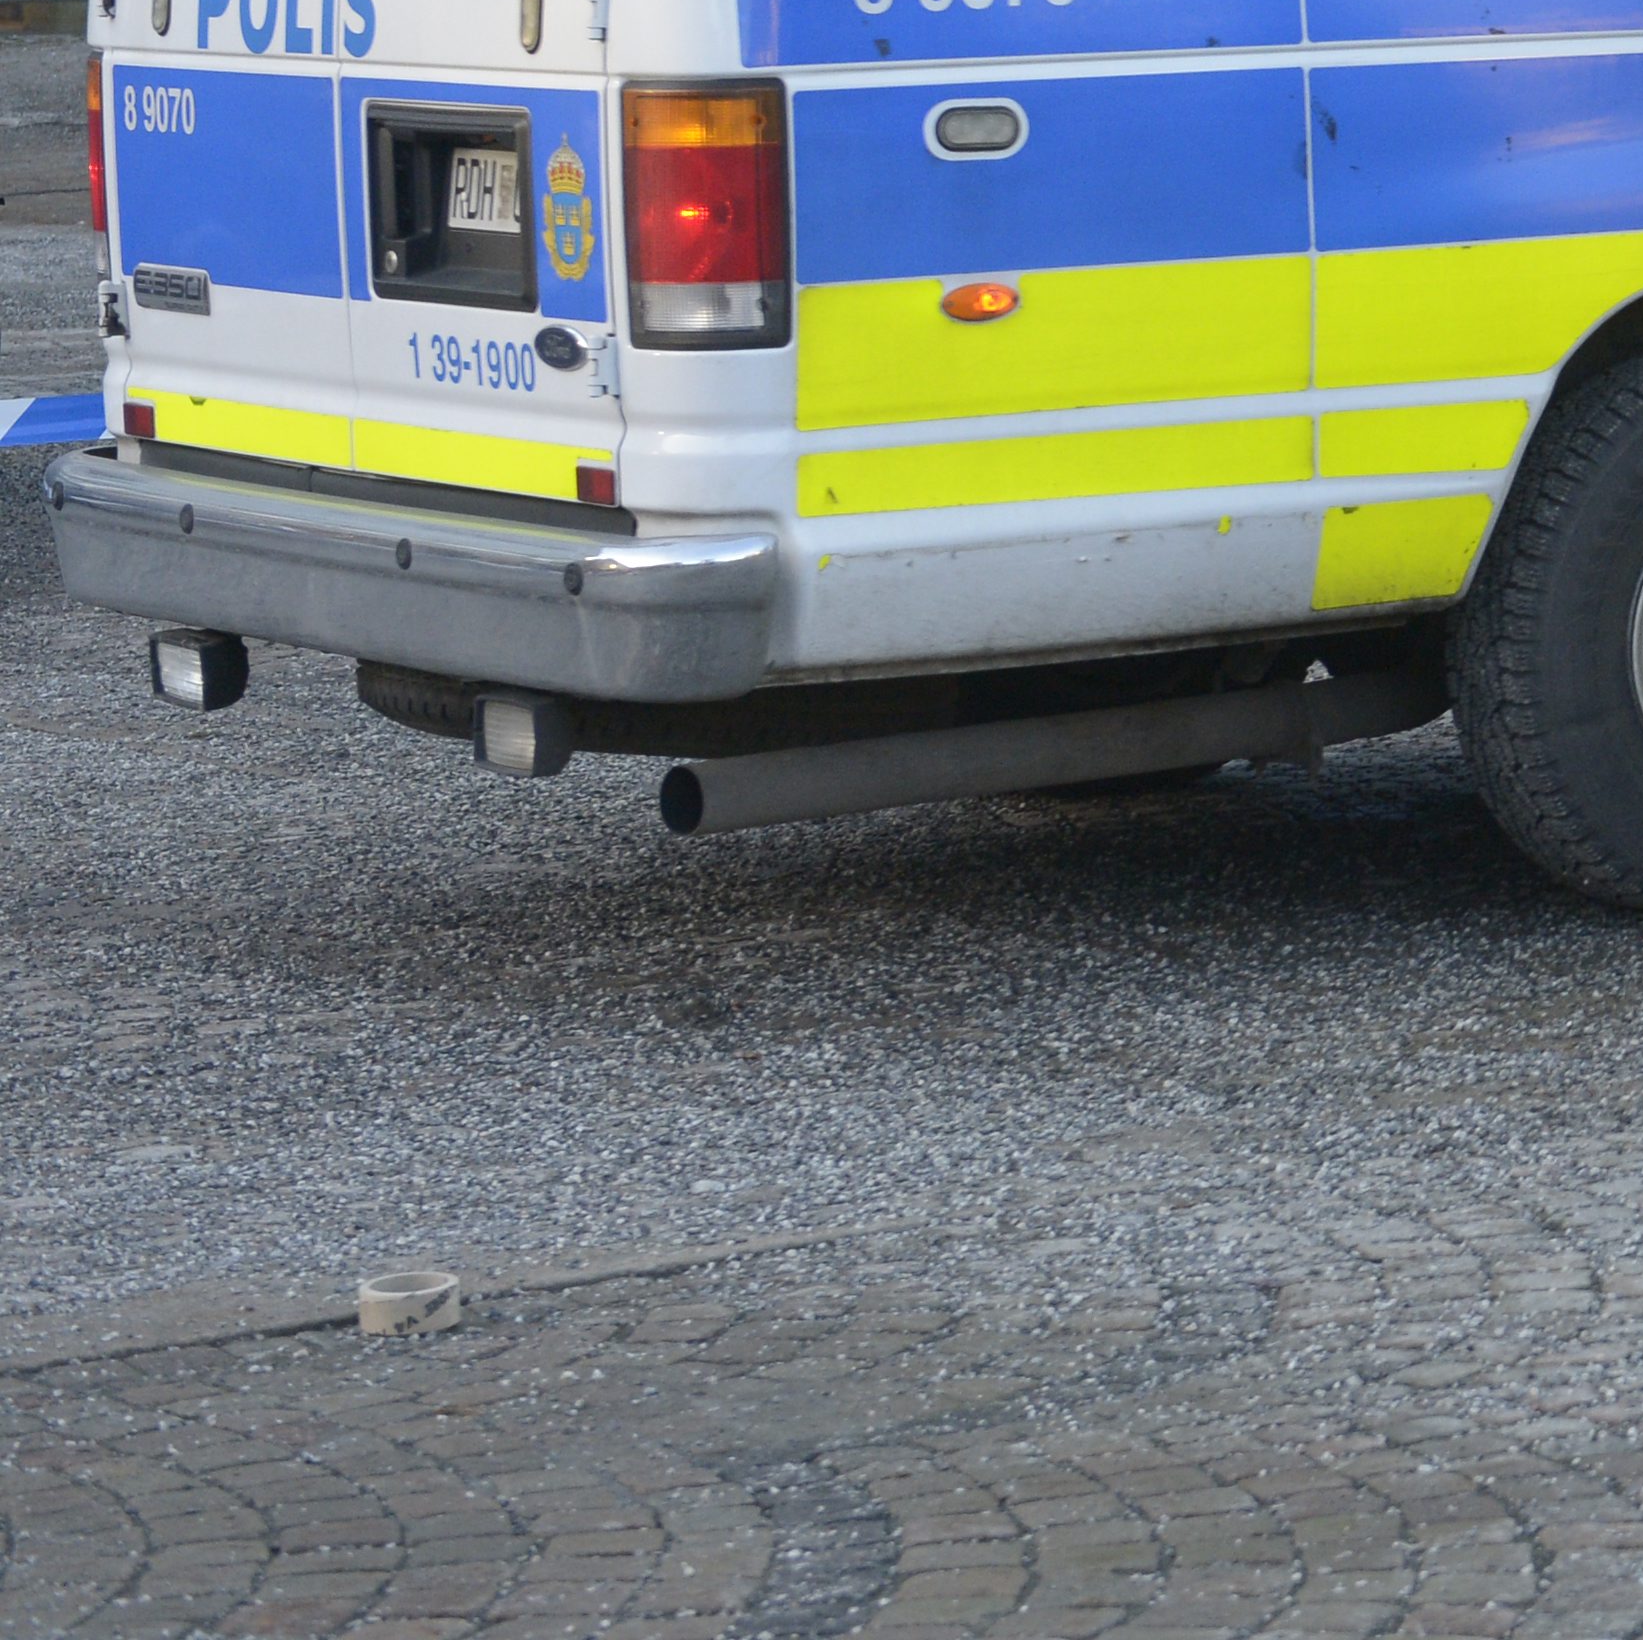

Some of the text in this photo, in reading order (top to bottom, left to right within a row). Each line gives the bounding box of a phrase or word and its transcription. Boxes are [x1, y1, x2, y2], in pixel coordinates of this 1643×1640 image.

[124, 85, 196, 135] 8 9070
[452, 157, 497, 221] RDH
[408, 332, 421, 379] 1
[431, 334, 537, 392] 39-1900
